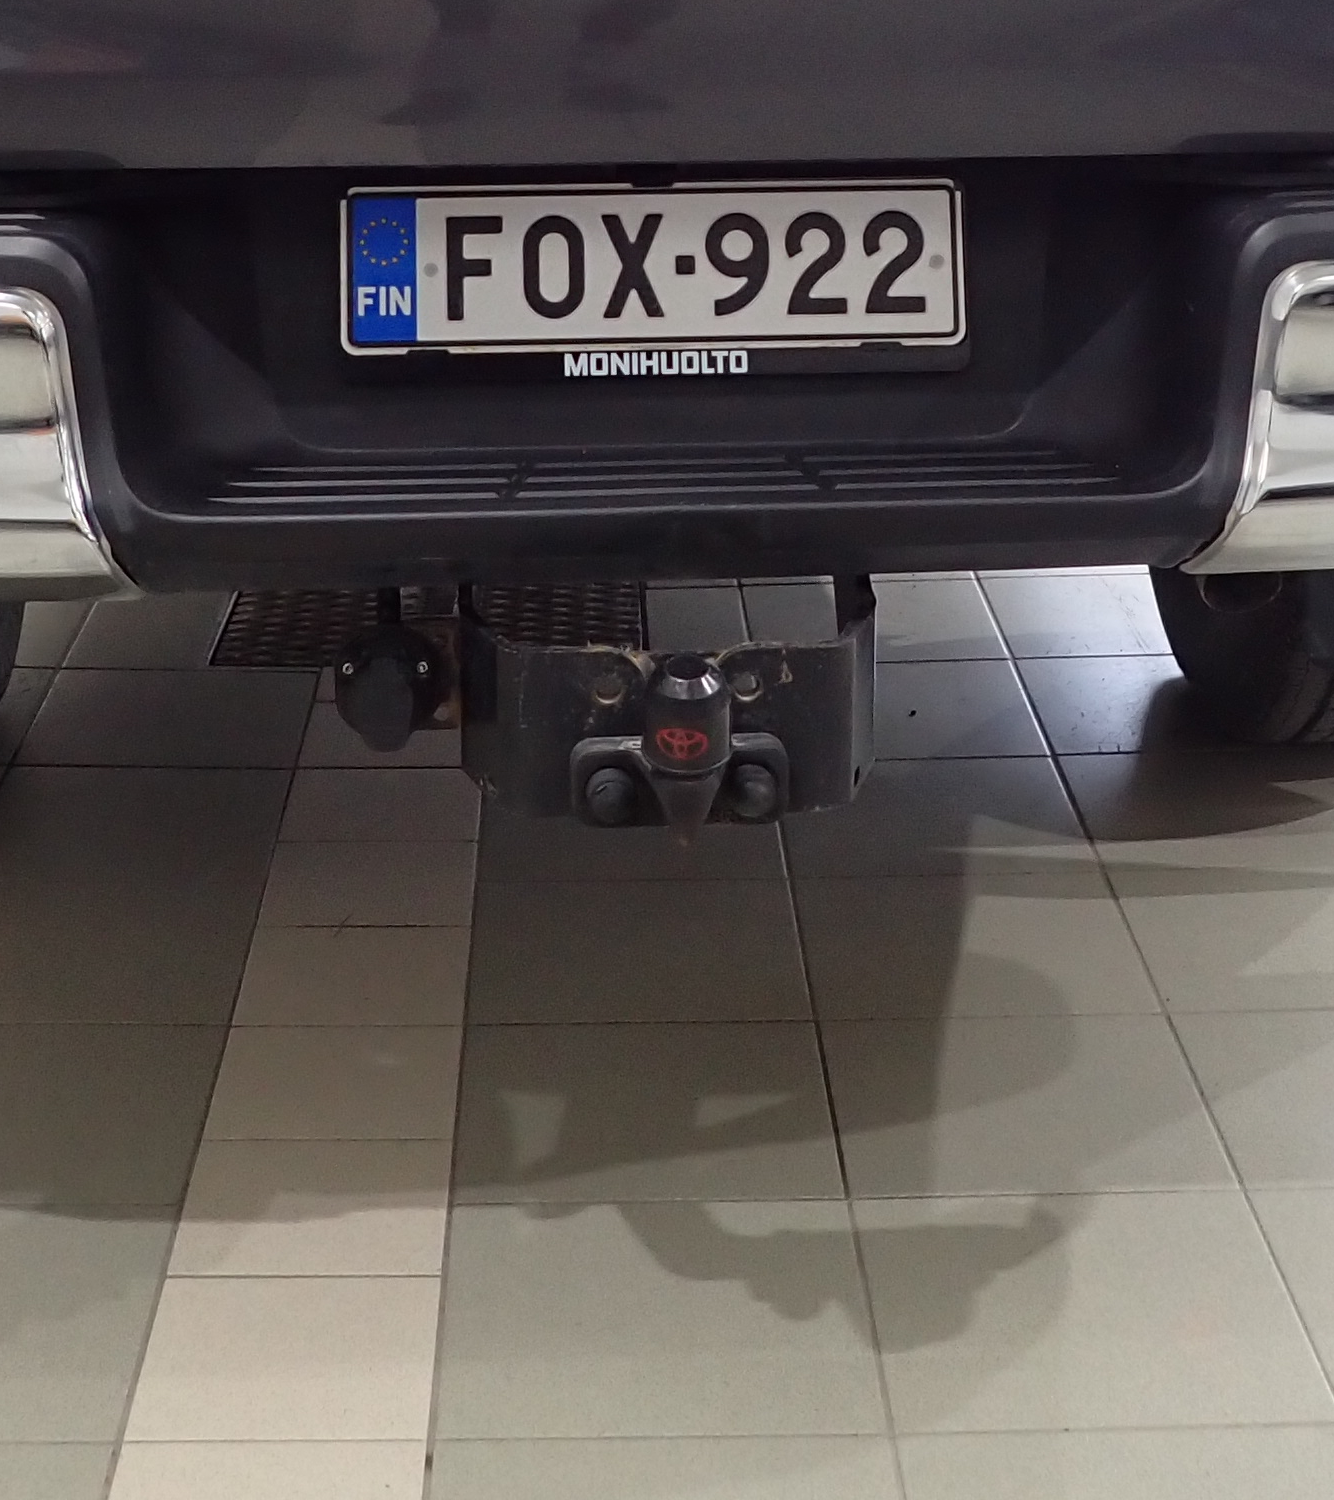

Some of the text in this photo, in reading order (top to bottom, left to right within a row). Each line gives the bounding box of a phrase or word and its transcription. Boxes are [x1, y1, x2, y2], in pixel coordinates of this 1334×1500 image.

[444, 211, 927, 322] FOX-922
[357, 286, 412, 318] FIN
[563, 349, 749, 378] MONIHUOLTO
